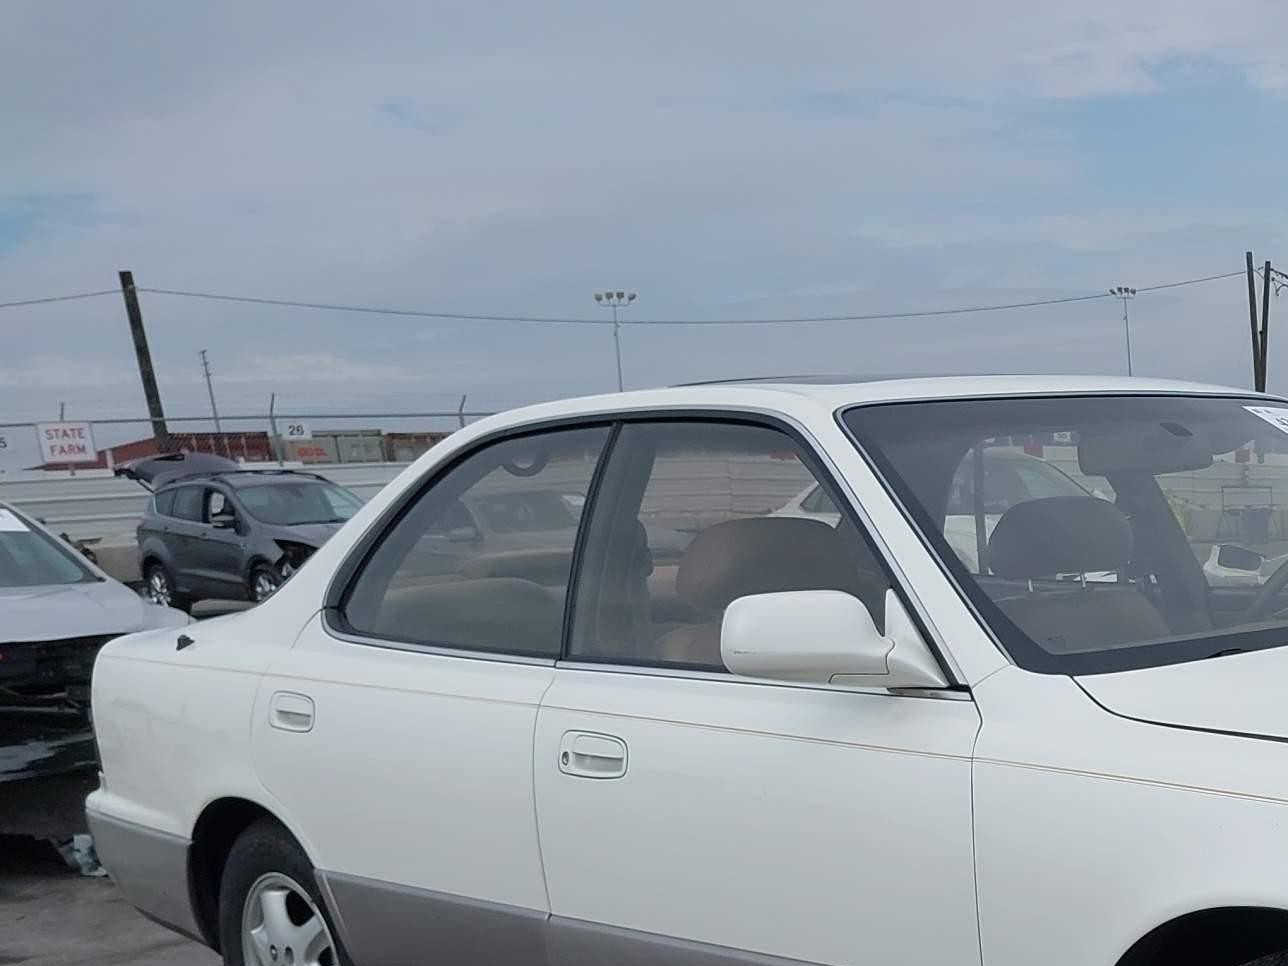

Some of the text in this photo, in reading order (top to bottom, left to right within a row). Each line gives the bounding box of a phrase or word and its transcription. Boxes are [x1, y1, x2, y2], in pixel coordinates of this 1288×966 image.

[45, 428, 86, 440] STATE
[288, 425, 305, 436] 26
[50, 445, 87, 456] FARM
